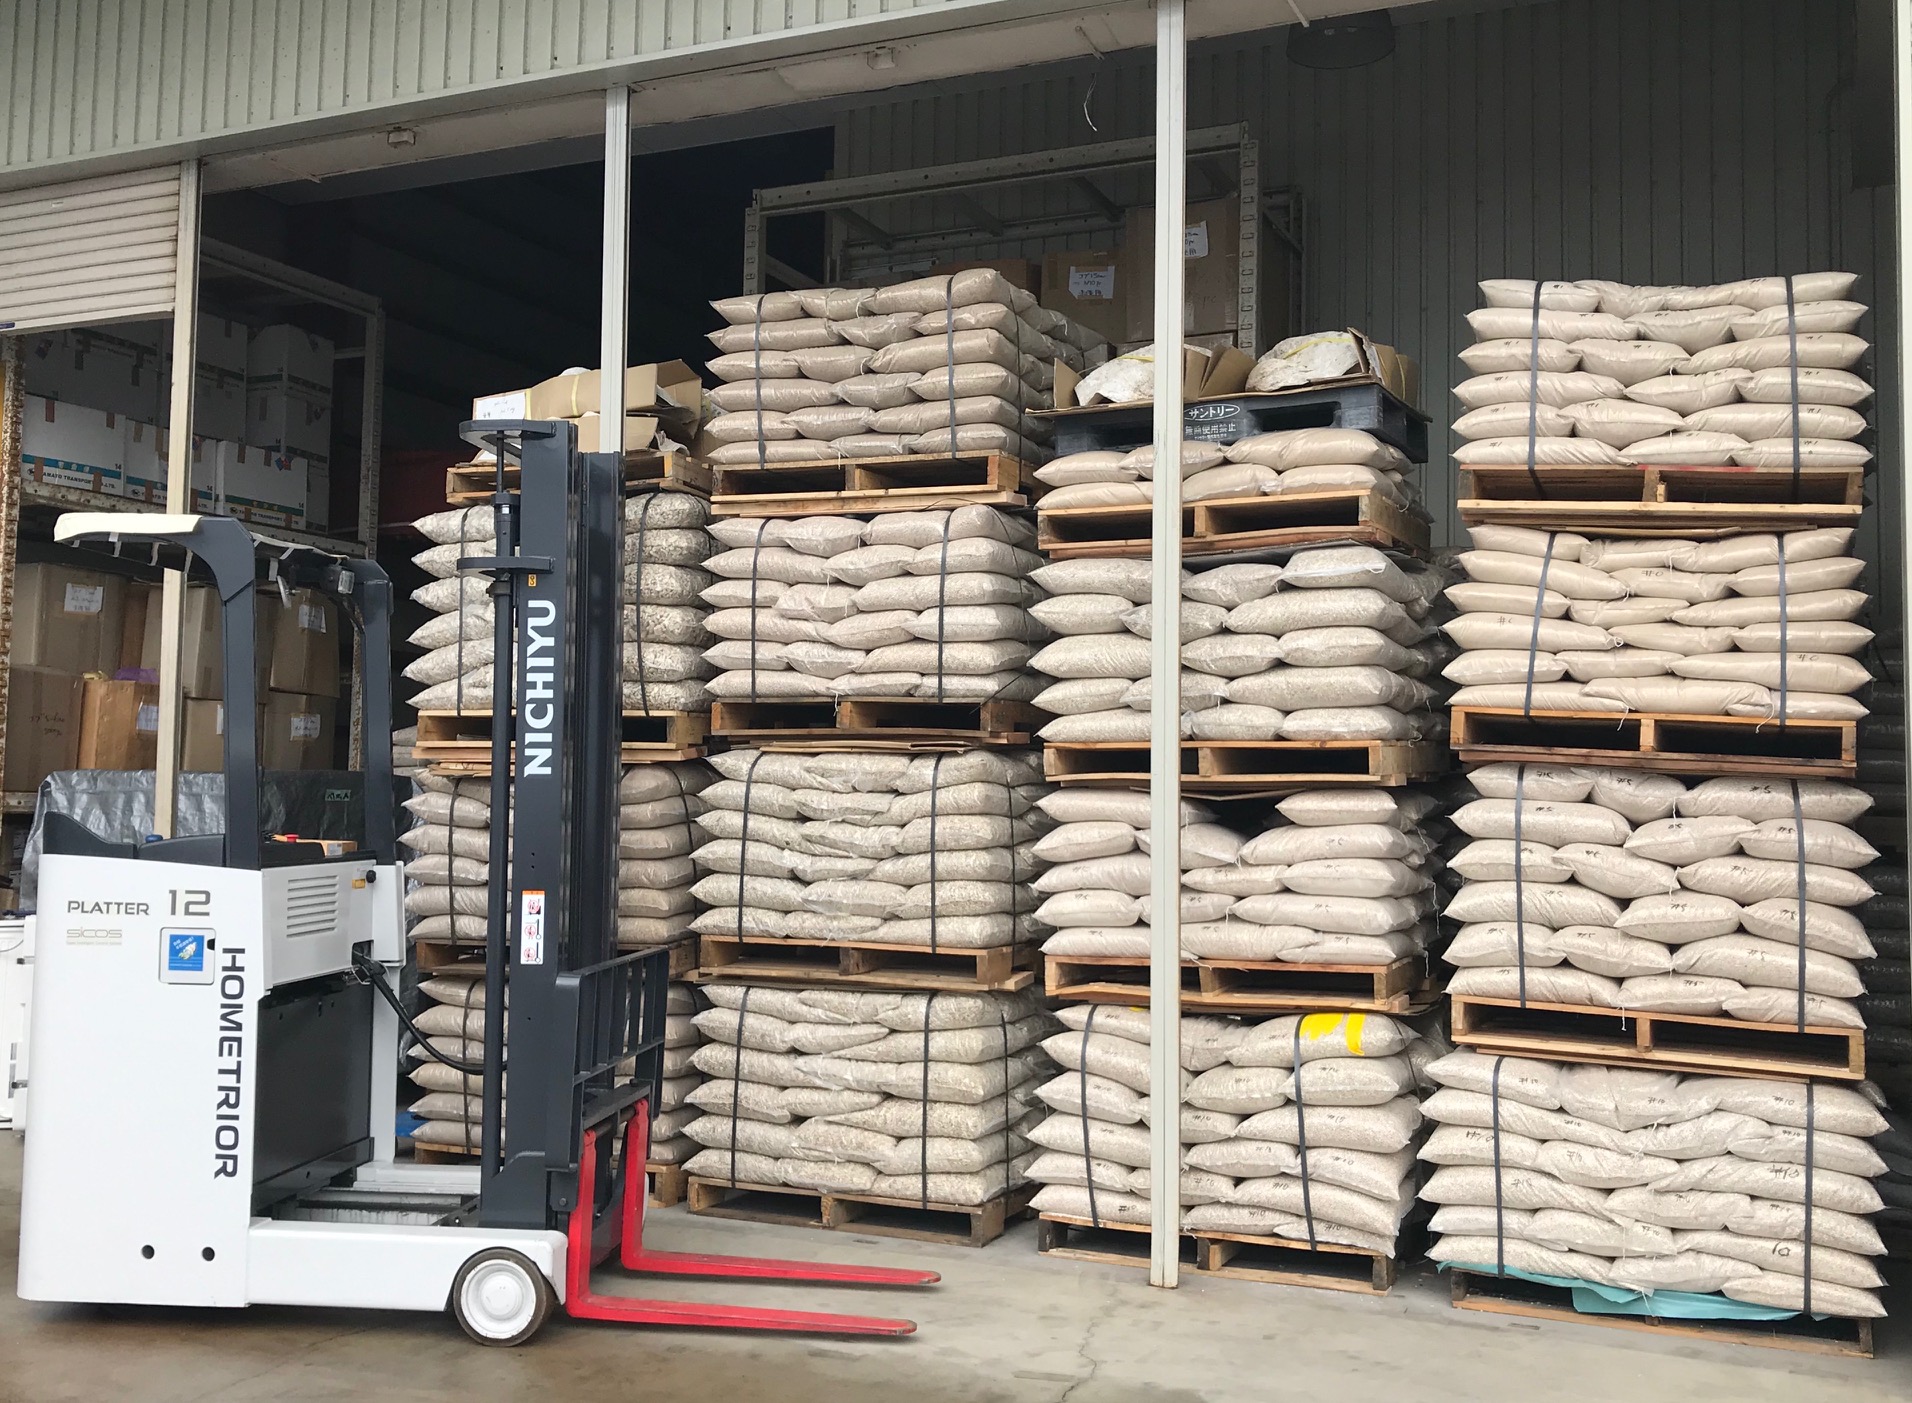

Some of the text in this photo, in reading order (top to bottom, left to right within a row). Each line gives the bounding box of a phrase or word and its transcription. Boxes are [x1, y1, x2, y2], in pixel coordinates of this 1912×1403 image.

[1189, 406, 1234, 419] サントリー
[63, 475, 92, 485] TRANSPOR
[523, 598, 556, 779] NICHIYU
[67, 889, 211, 916] PLATTER 12
[214, 947, 246, 1180] HOMETRIOR
[1772, 1242, 1791, 1257] 10
